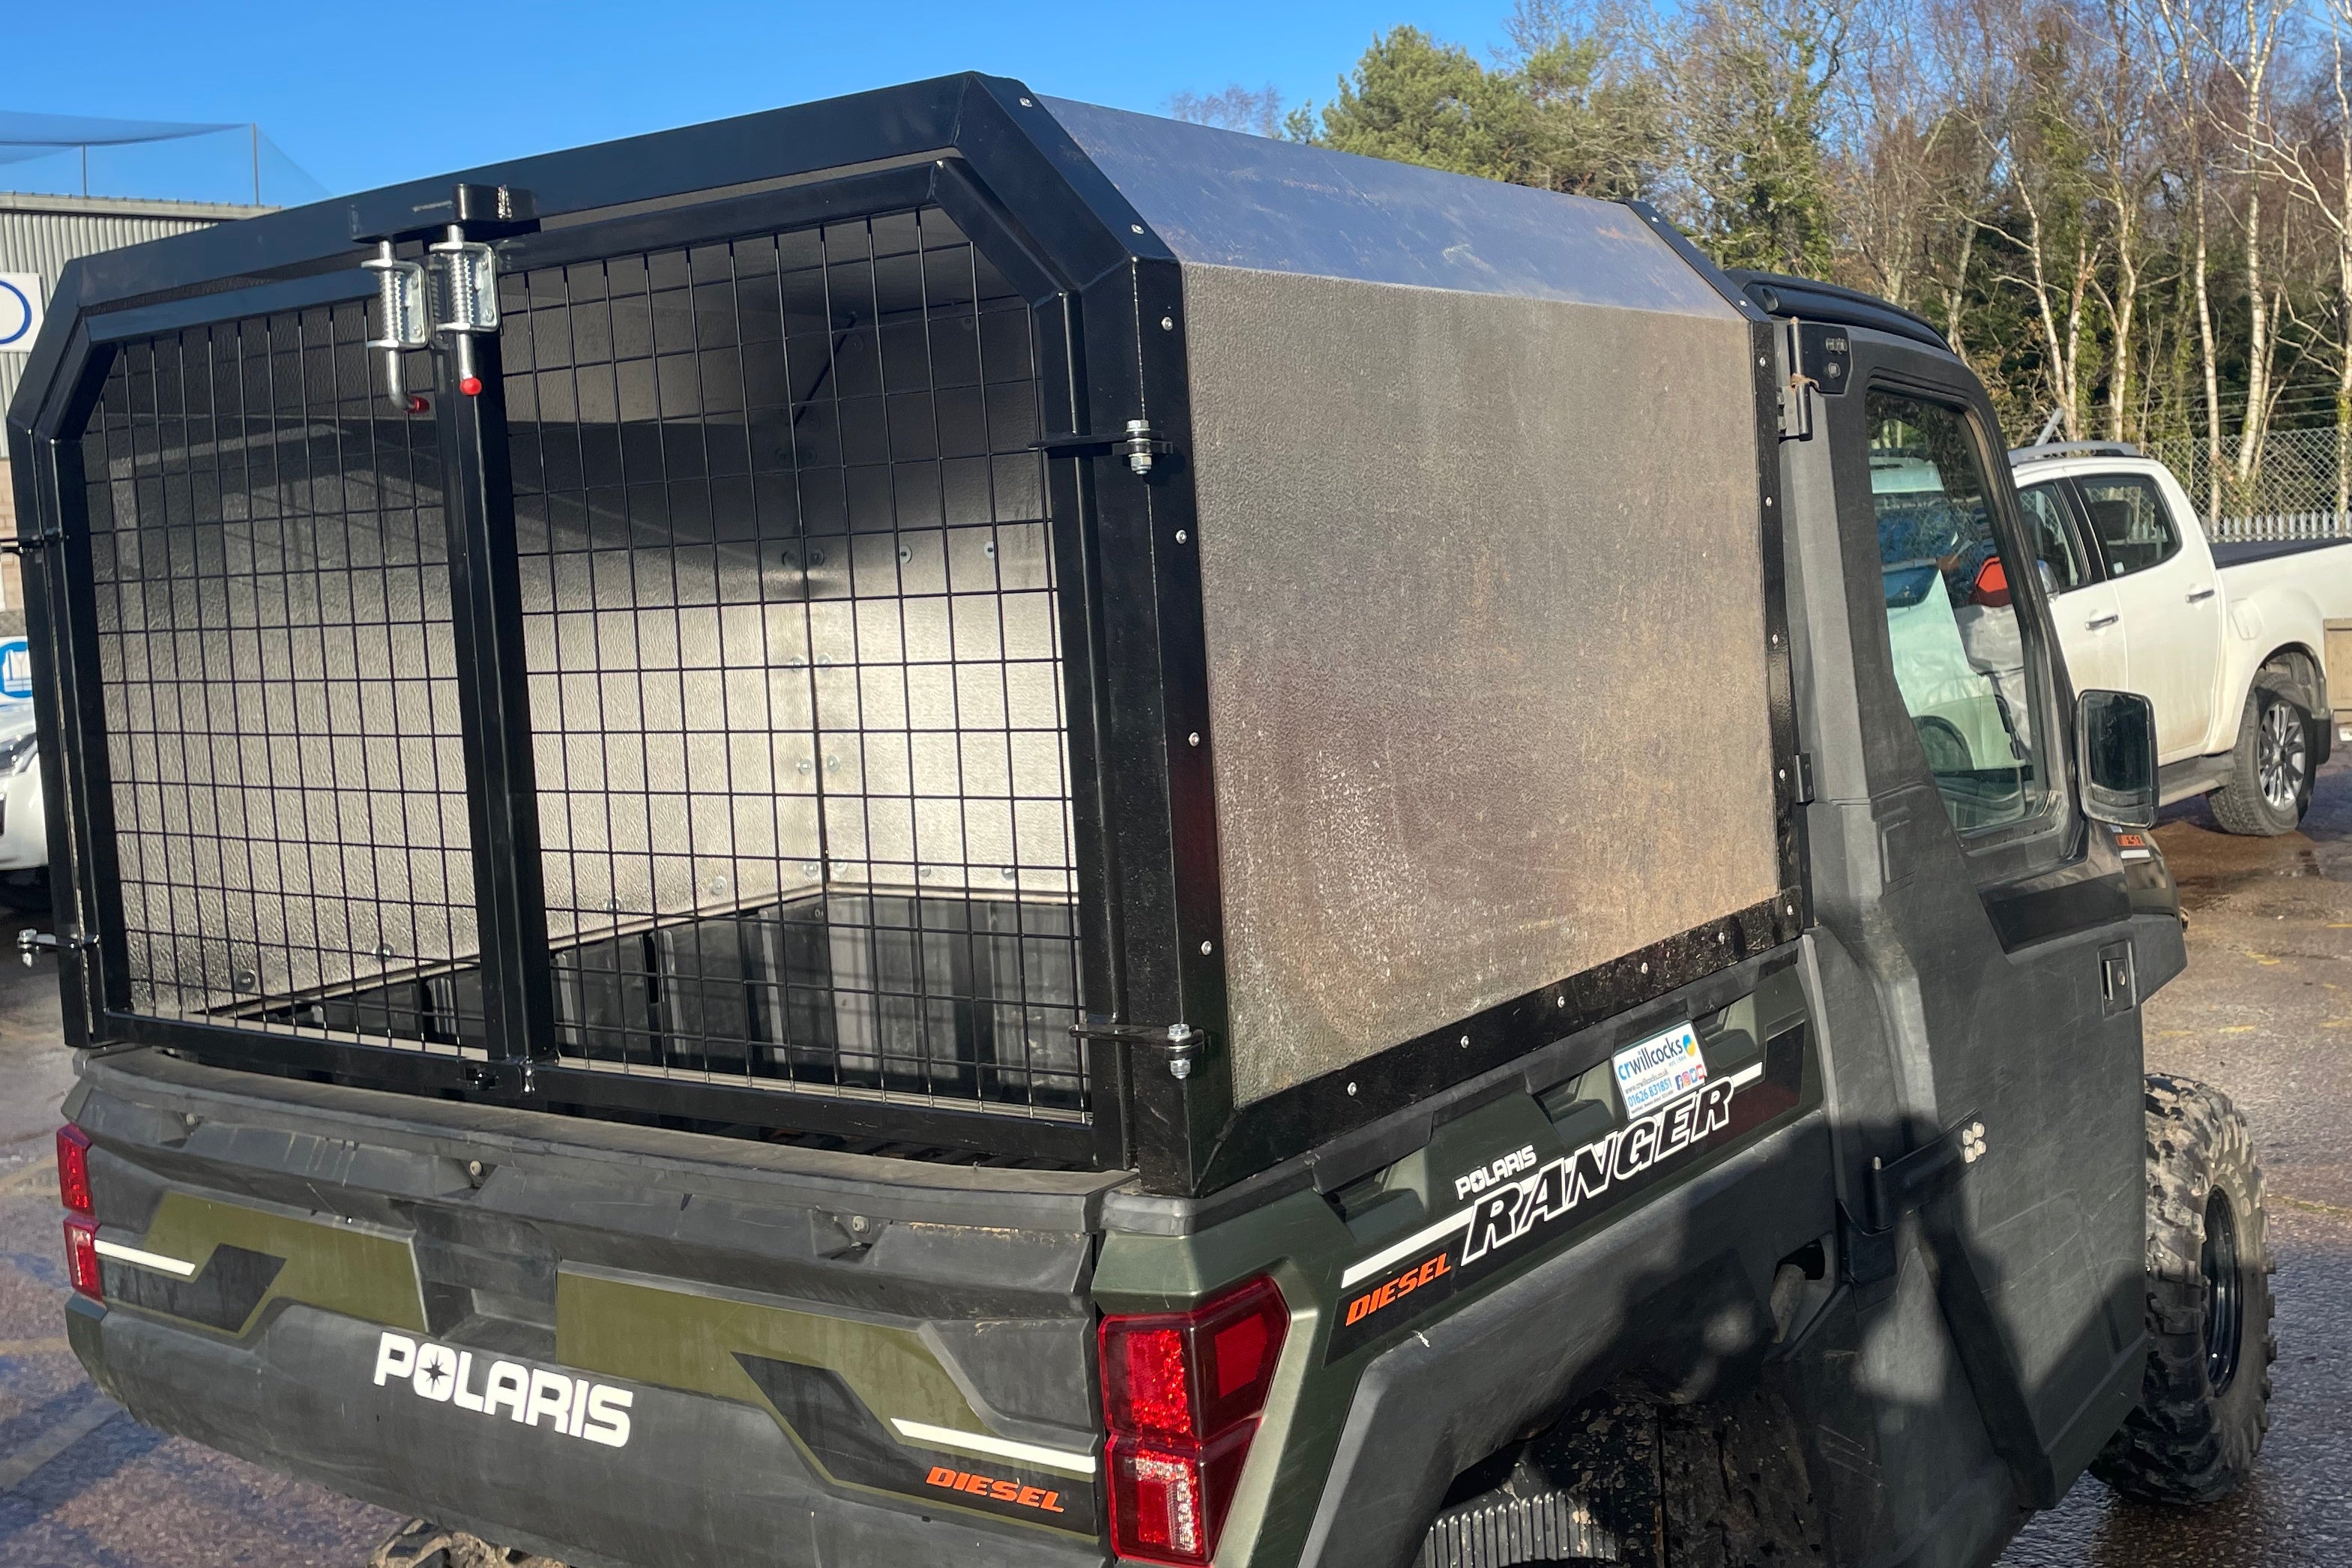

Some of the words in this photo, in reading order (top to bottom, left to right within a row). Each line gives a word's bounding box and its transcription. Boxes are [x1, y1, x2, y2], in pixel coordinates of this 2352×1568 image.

[1618, 1037, 1683, 1080] crwillcocks
[1627, 1088, 1649, 1107] 01626
[1648, 1077, 1673, 1097] 831851
[1456, 1145, 1537, 1201] POLARIS
[1461, 1076, 1734, 1266] RANGER
[1346, 1252, 1451, 1326] DIESEL
[373, 1331, 634, 1448] POLARIS
[925, 1466, 1065, 1513] DIESEL
